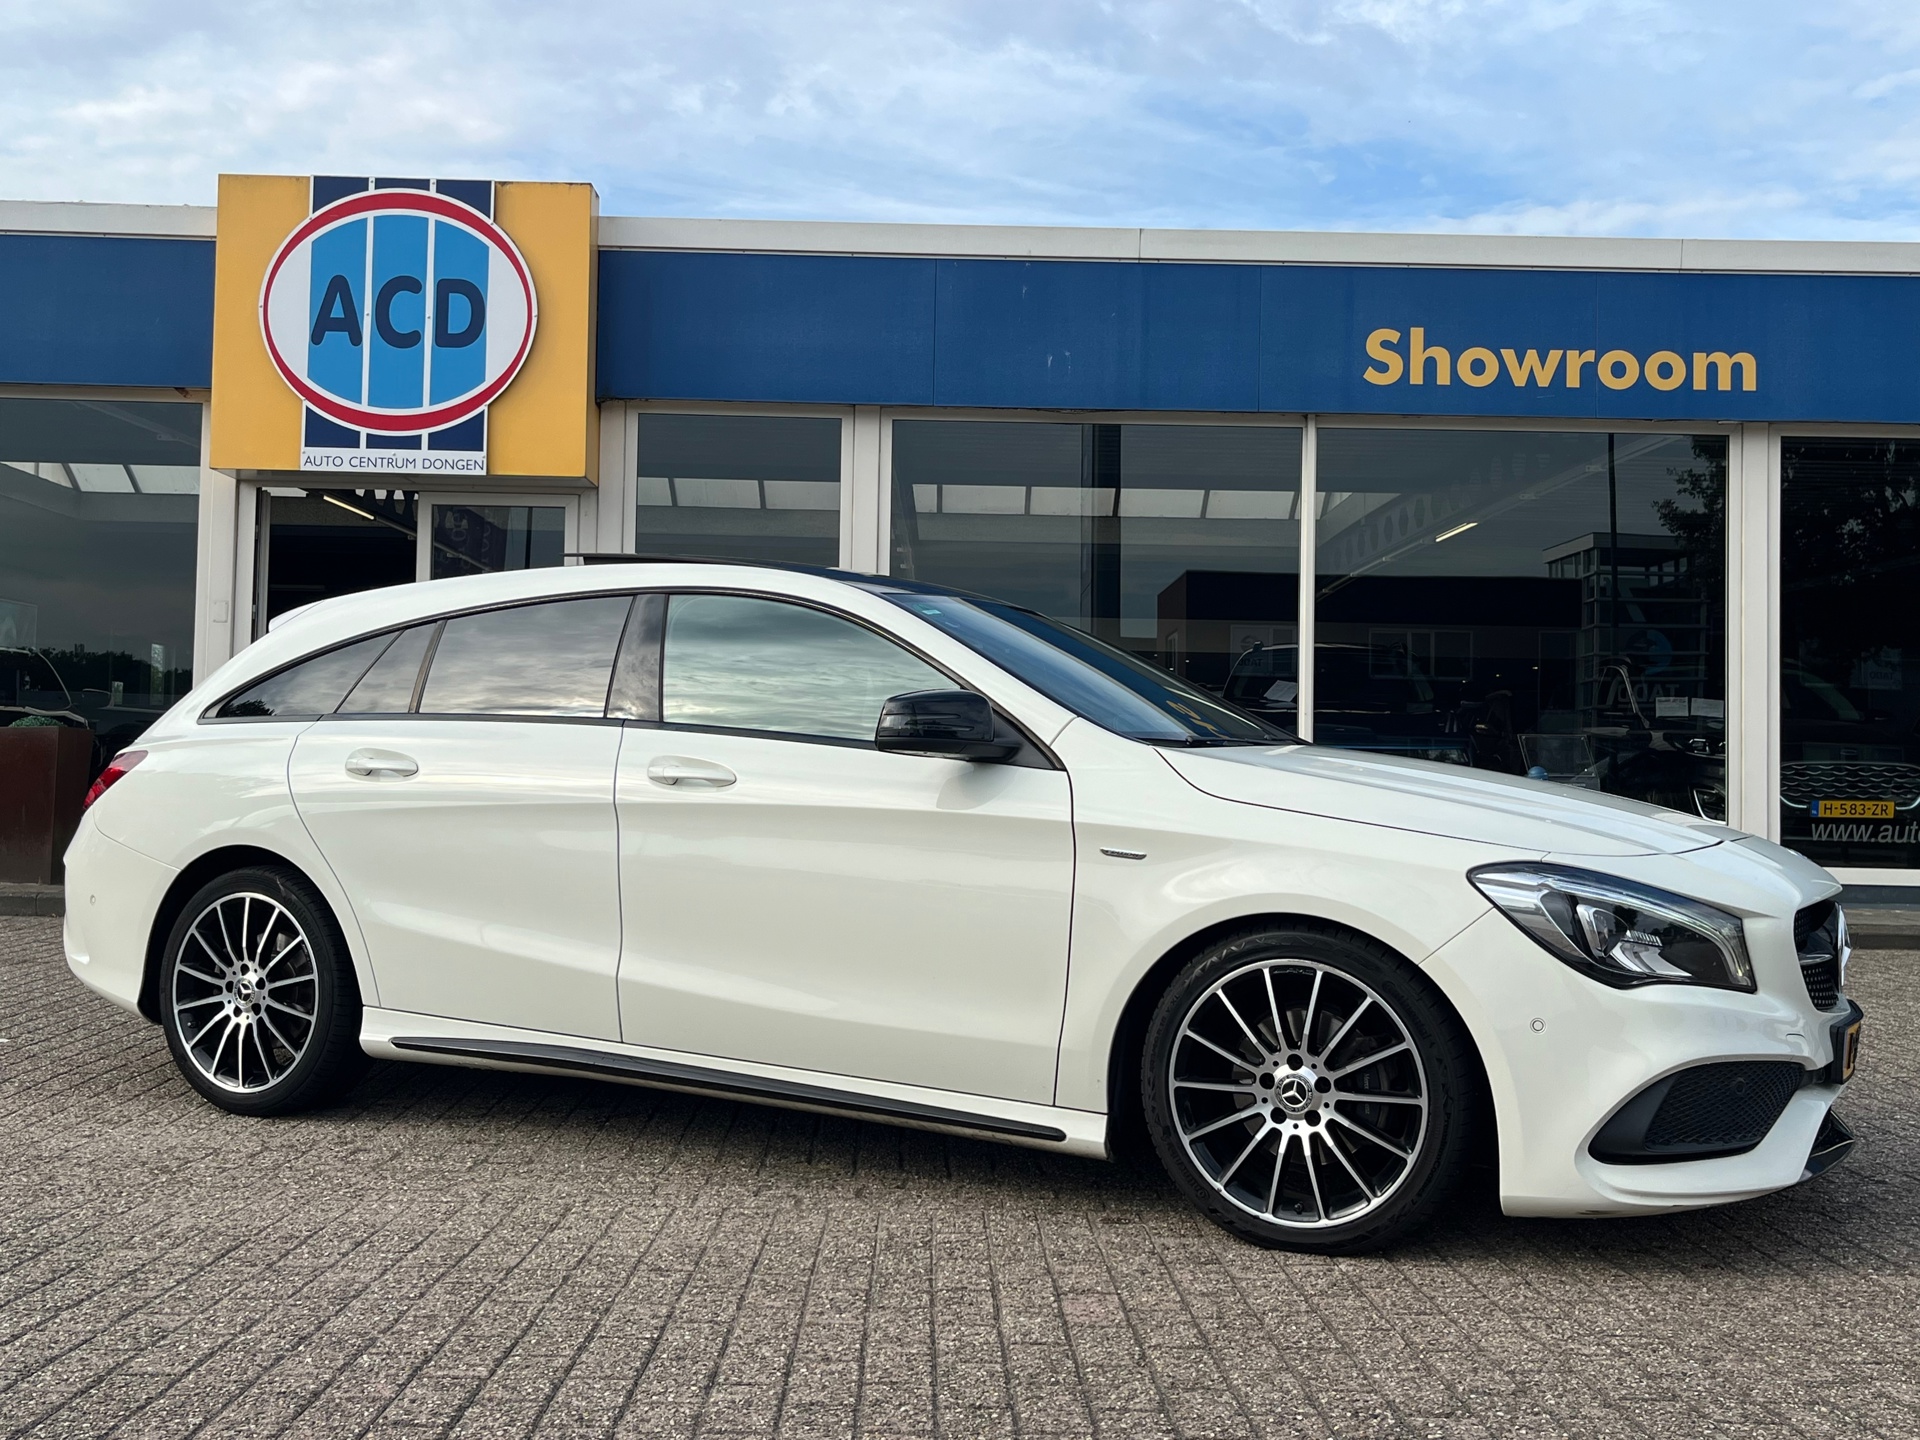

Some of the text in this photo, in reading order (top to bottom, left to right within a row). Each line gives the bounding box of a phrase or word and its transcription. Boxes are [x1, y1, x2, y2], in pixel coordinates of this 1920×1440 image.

[311, 274, 485, 348] ACD
[1363, 327, 1757, 391] Showroom
[304, 456, 484, 471] AUTO CENTRUM DONGEN
[1824, 803, 1888, 816] H-583-ZR
[1811, 821, 1920, 844] www.aut
